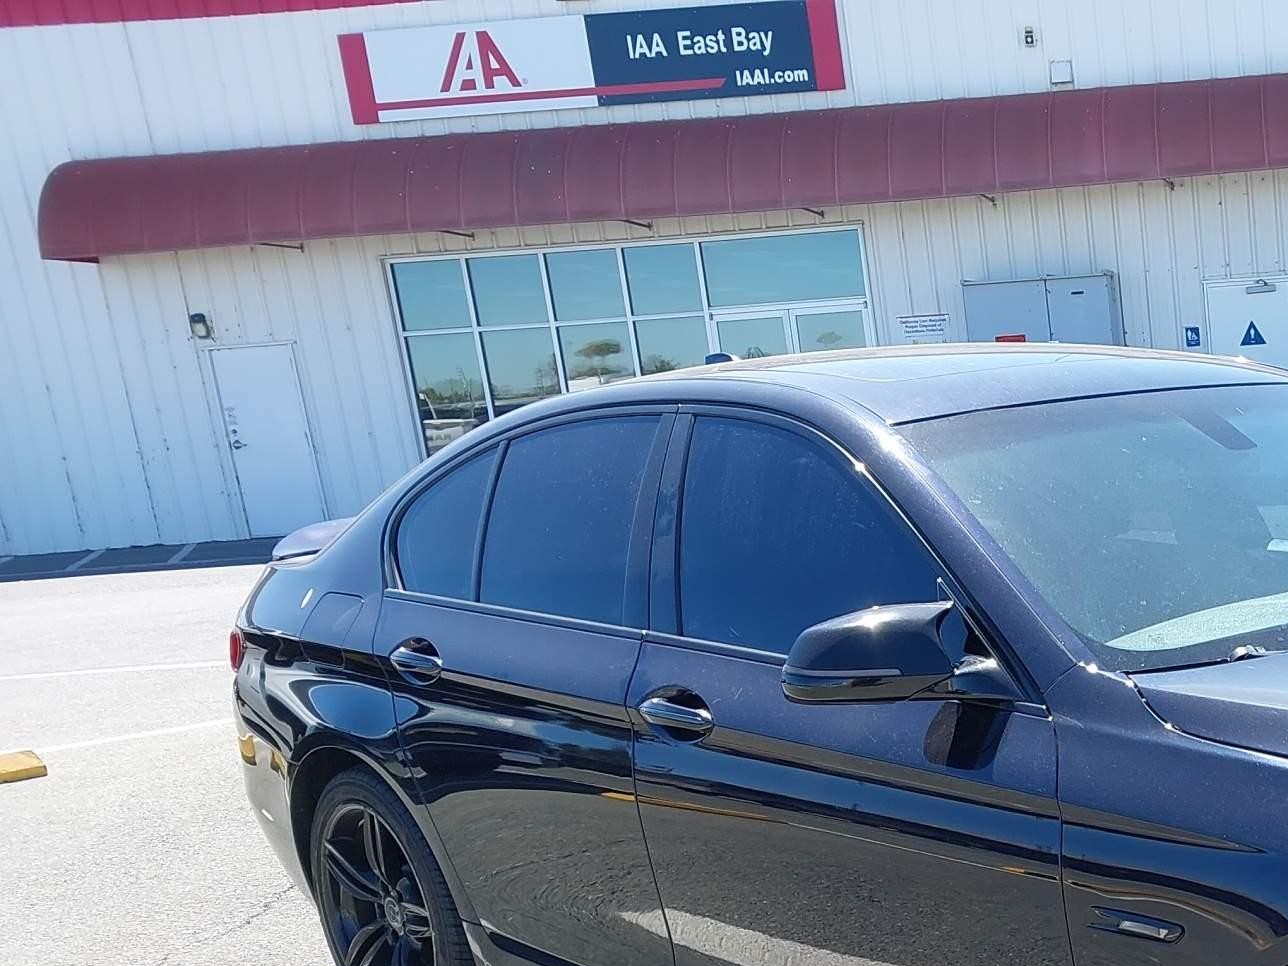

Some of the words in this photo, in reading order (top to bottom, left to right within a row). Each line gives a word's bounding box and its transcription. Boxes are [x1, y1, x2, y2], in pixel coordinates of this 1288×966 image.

[626, 32, 668, 59] IAA
[677, 29, 728, 56] East
[731, 27, 773, 56] Bay
[735, 68, 809, 87] IAAI.com
